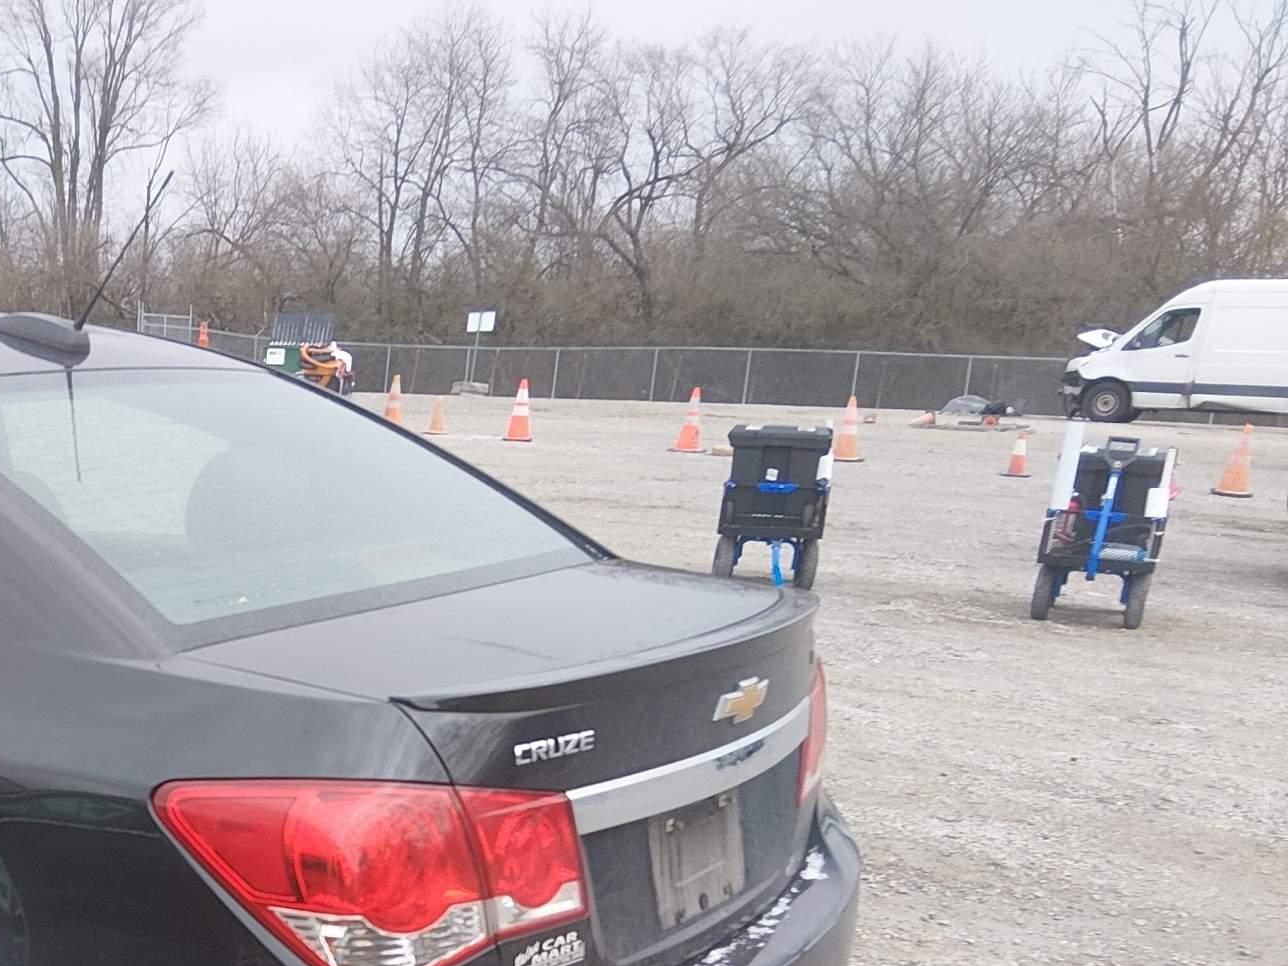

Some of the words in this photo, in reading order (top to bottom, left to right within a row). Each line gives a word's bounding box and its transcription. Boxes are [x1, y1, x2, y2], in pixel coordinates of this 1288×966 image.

[514, 730, 595, 766] CRUZE
[531, 940, 583, 966] MART
[541, 931, 578, 951] CAR
